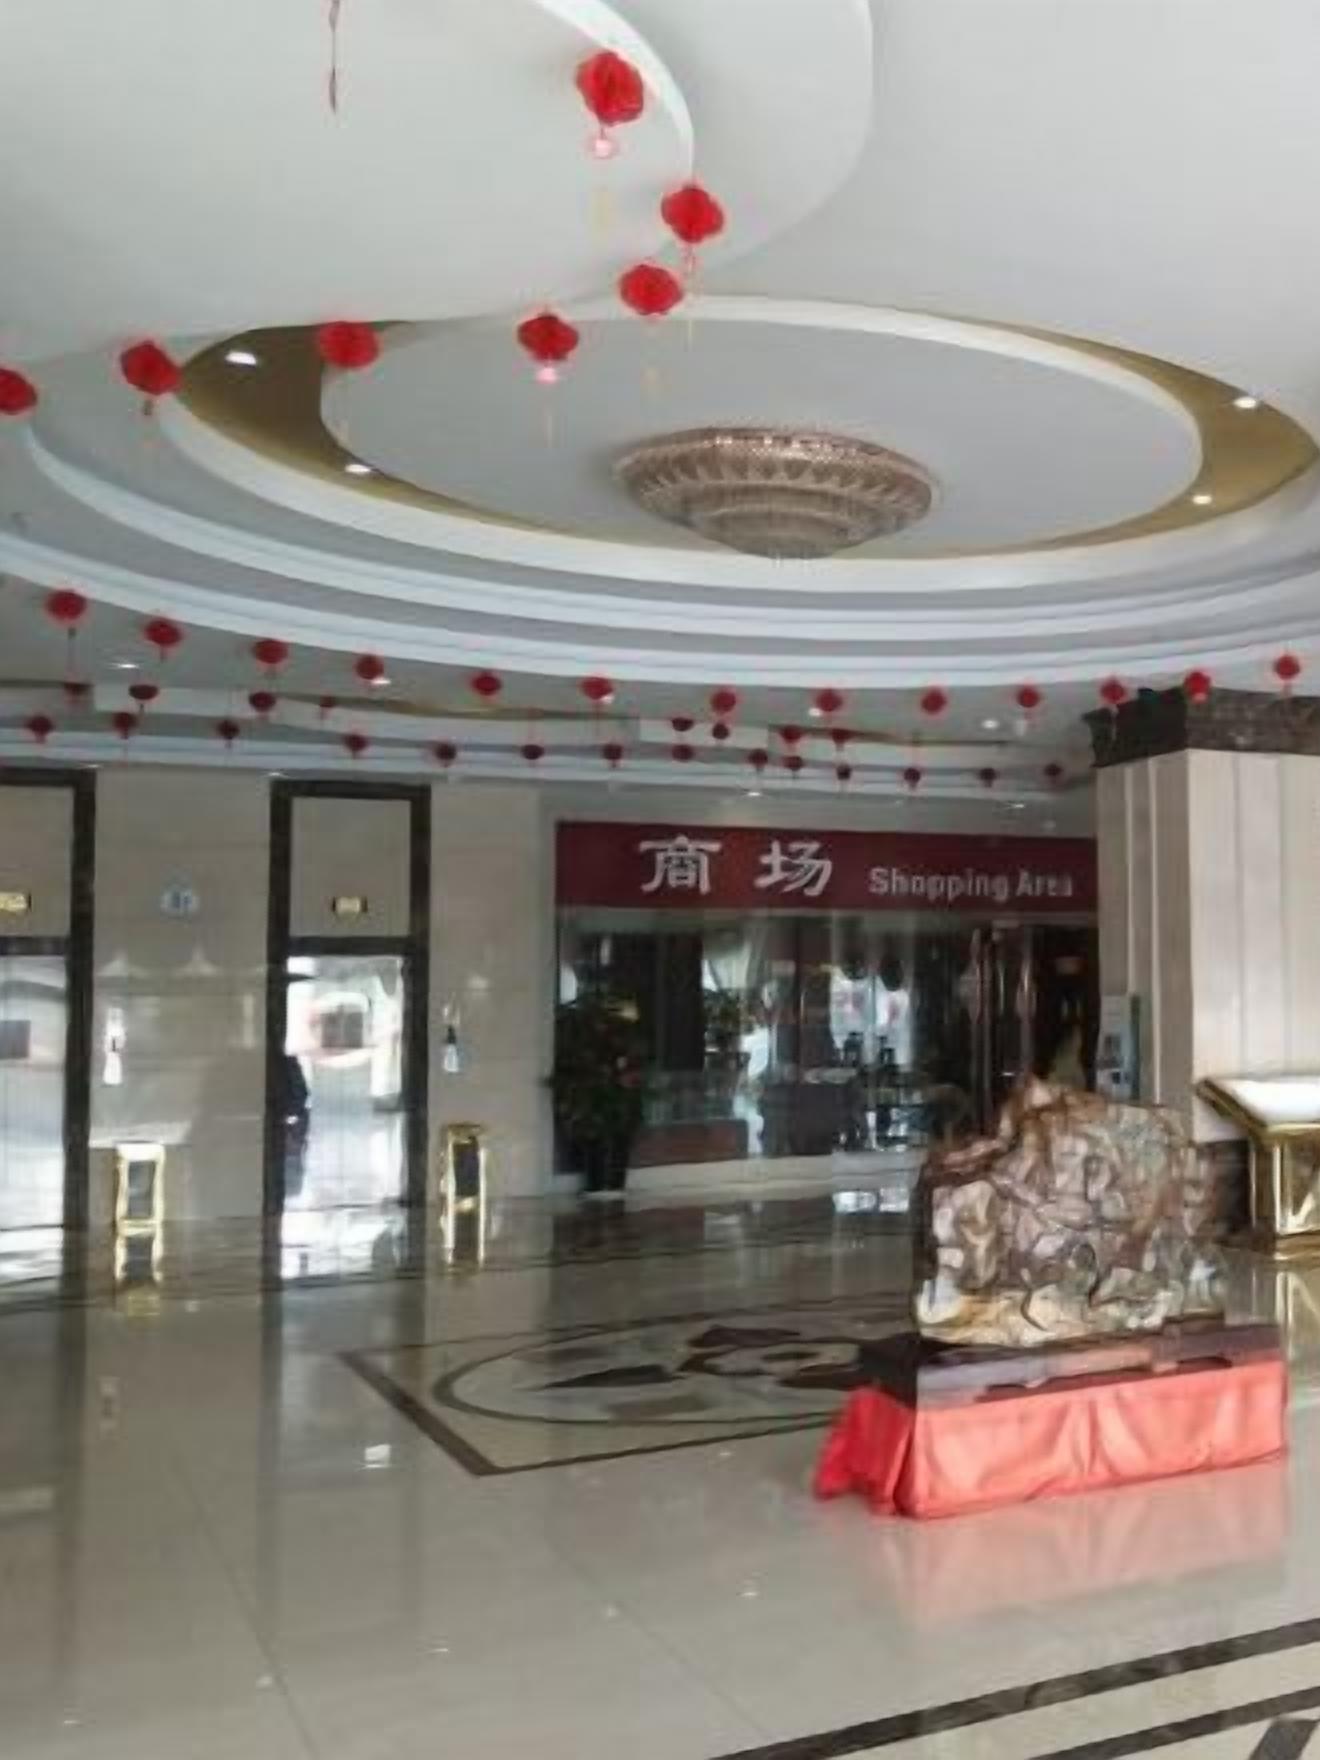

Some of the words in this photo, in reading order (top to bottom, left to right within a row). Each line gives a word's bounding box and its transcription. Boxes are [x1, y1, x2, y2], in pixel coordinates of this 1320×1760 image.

[638, 834, 833, 896] 商场
[867, 865, 1008, 903] Shopping
[1015, 869, 1074, 897] Area
